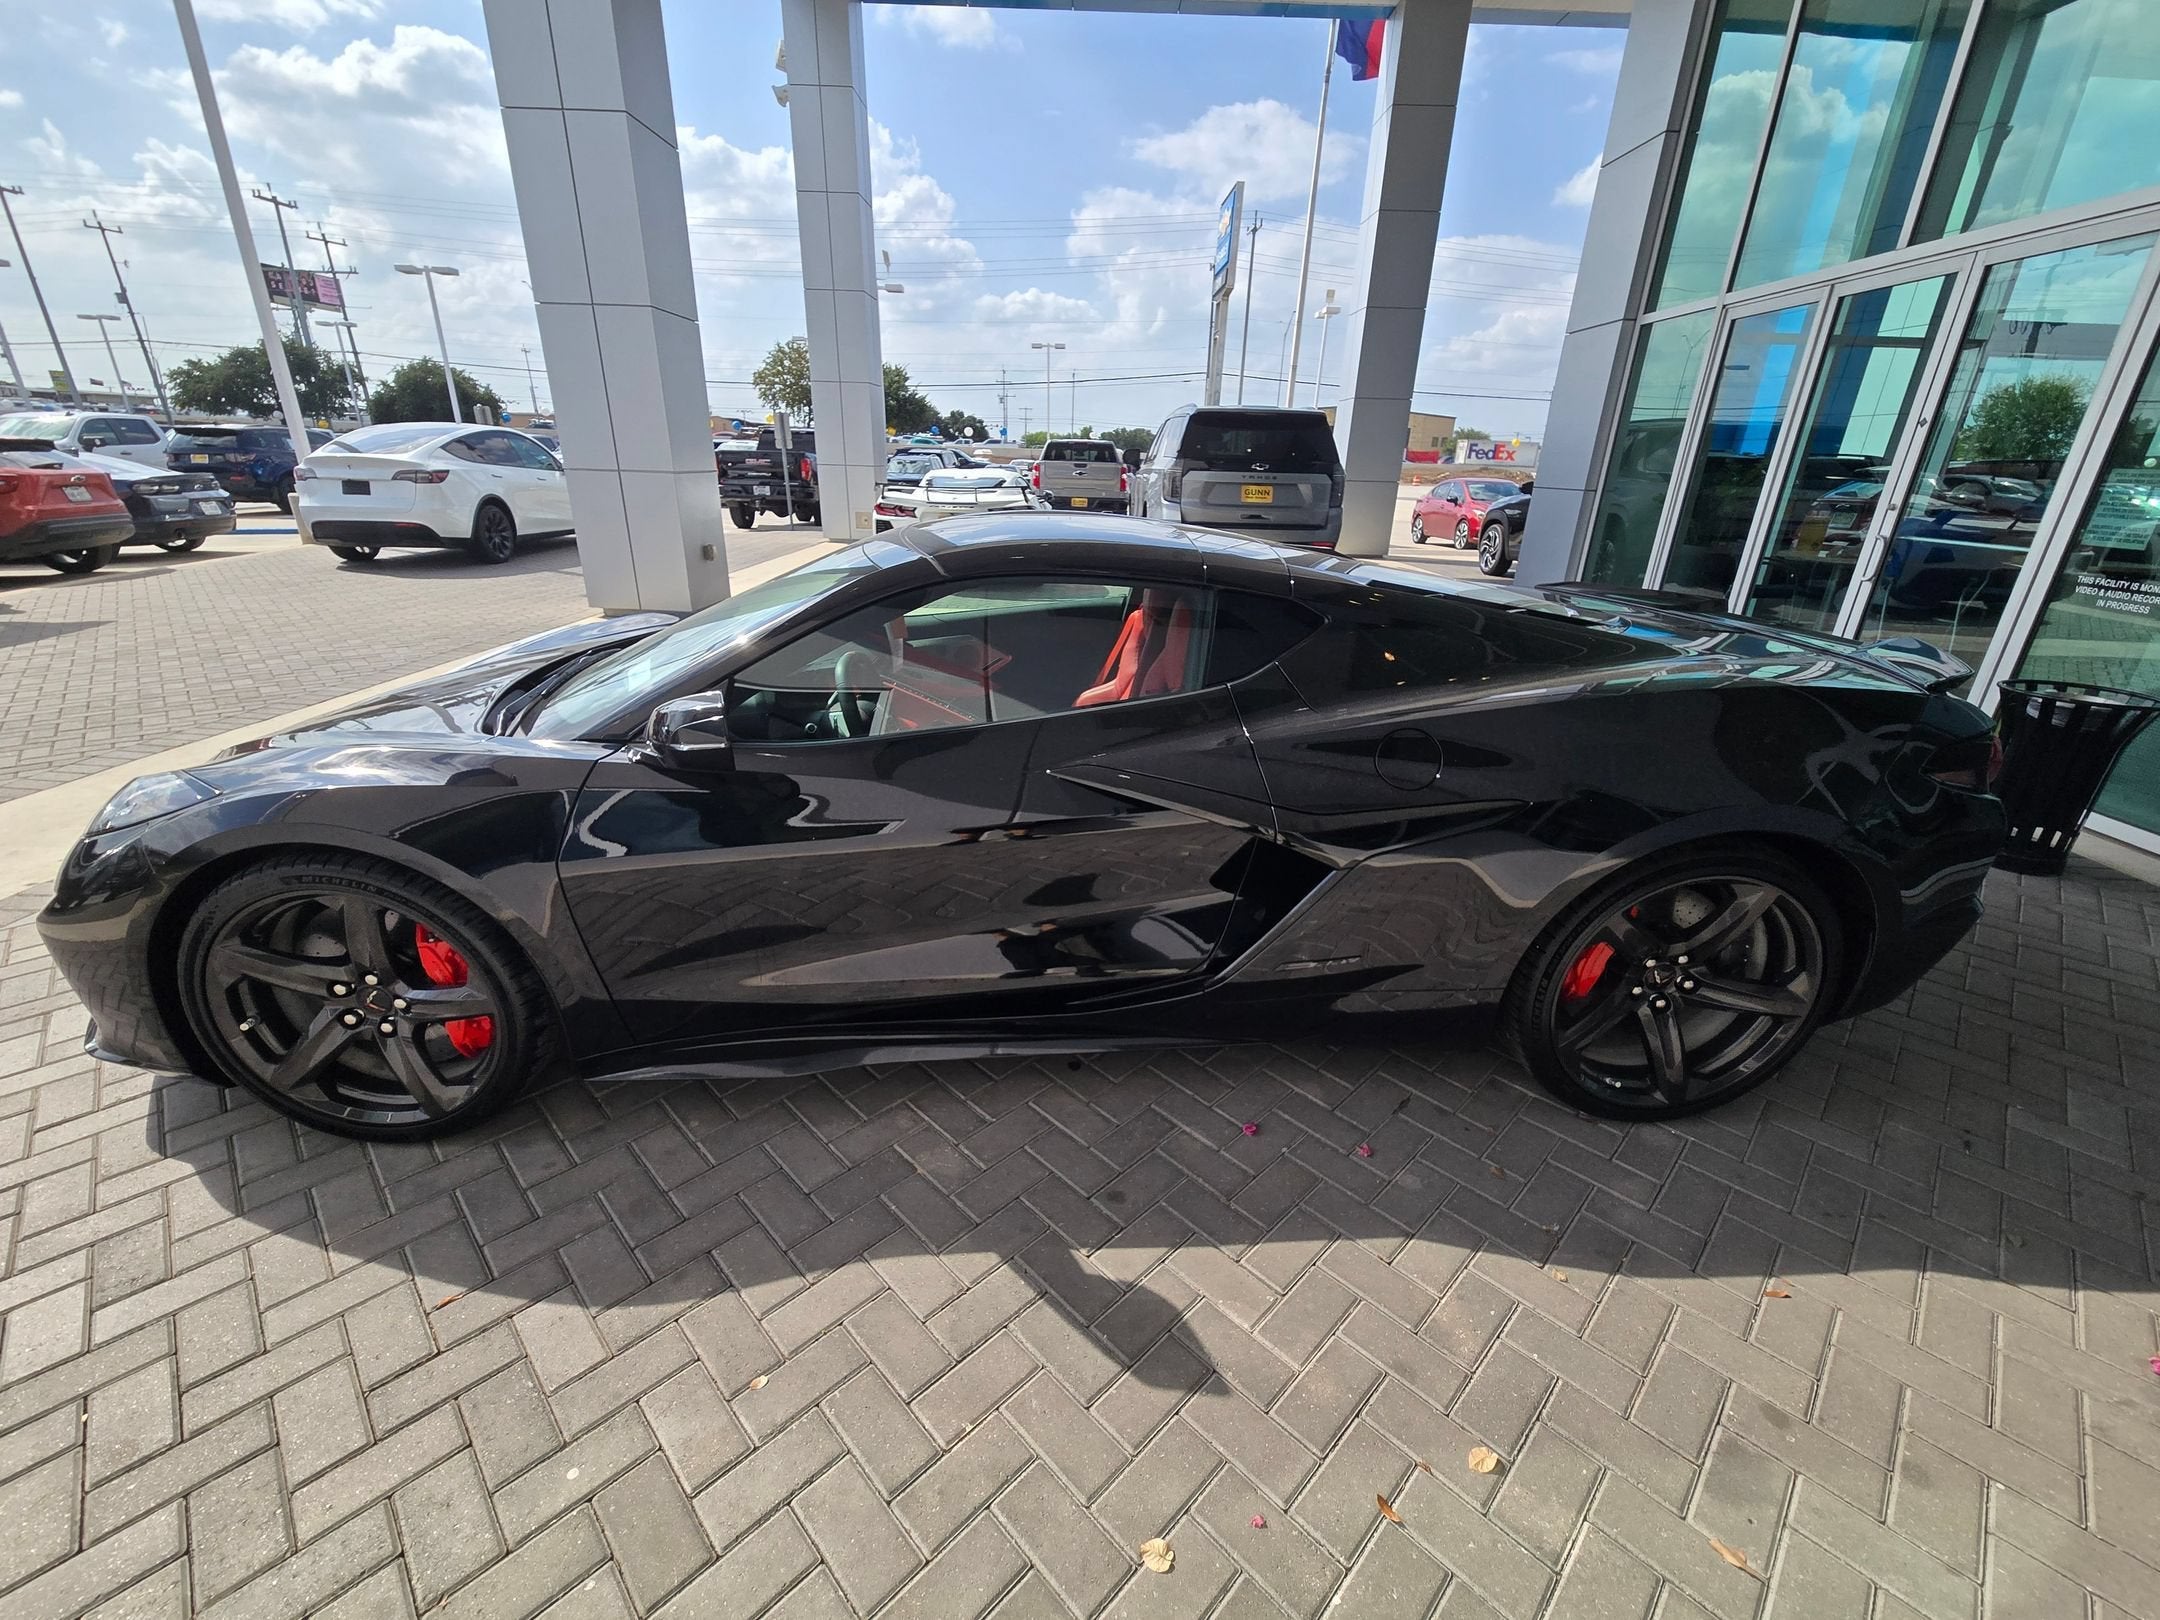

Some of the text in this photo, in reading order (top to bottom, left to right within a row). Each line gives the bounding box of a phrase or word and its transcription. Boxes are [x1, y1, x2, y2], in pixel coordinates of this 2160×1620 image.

[1467, 443, 1516, 461] FedEx
[1244, 488, 1271, 496] GUNN
[2075, 585, 2098, 595] VIDEO
[2098, 588, 2105, 597] &
[2105, 590, 2131, 600] AUDIO
[2077, 575, 2160, 594] THIS FACILITY IS MON
[2096, 599, 2151, 614] IN PROGRESS
[302, 875, 377, 892] MICHELIN
